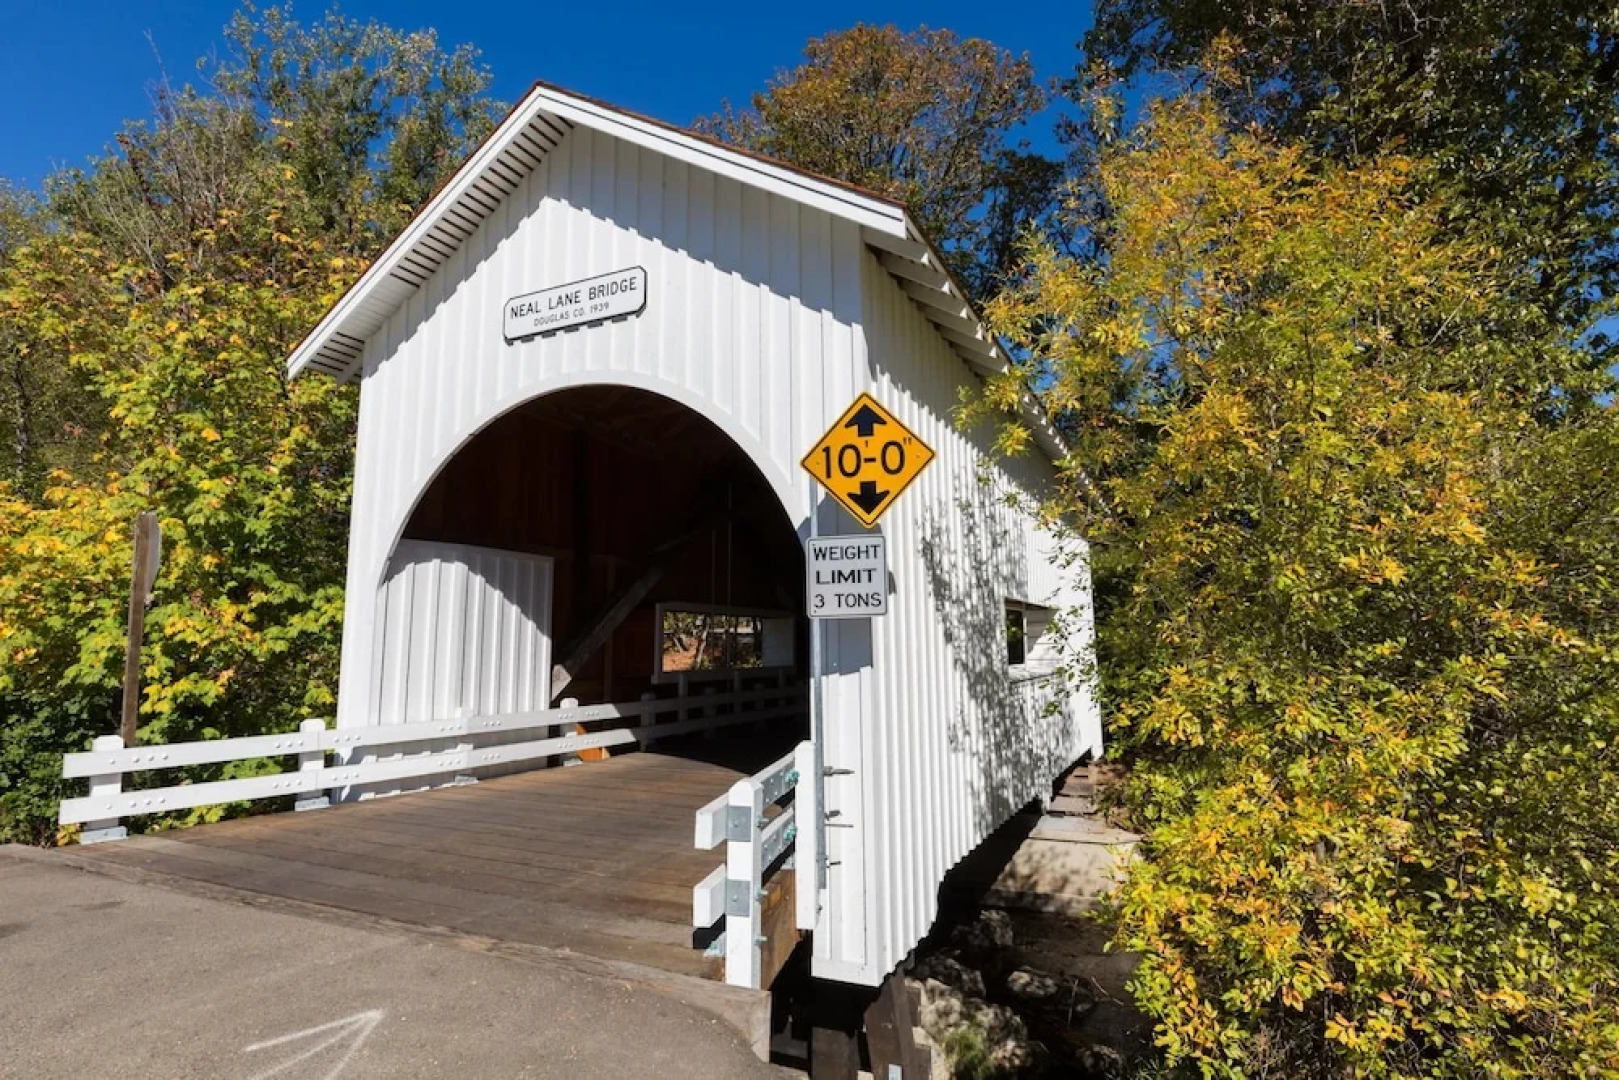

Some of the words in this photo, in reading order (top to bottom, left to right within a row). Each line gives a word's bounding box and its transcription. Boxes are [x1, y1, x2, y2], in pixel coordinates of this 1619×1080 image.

[510, 300, 541, 319] NEAL
[548, 290, 582, 310] LANE
[588, 276, 637, 301] BRIDGE
[533, 311, 569, 327] DOUGLAS
[590, 302, 610, 314] 1939
[813, 544, 881, 561] WEIGHT
[815, 567, 877, 585] LIMIT
[813, 593, 825, 609] 3
[834, 592, 882, 608] TONS
